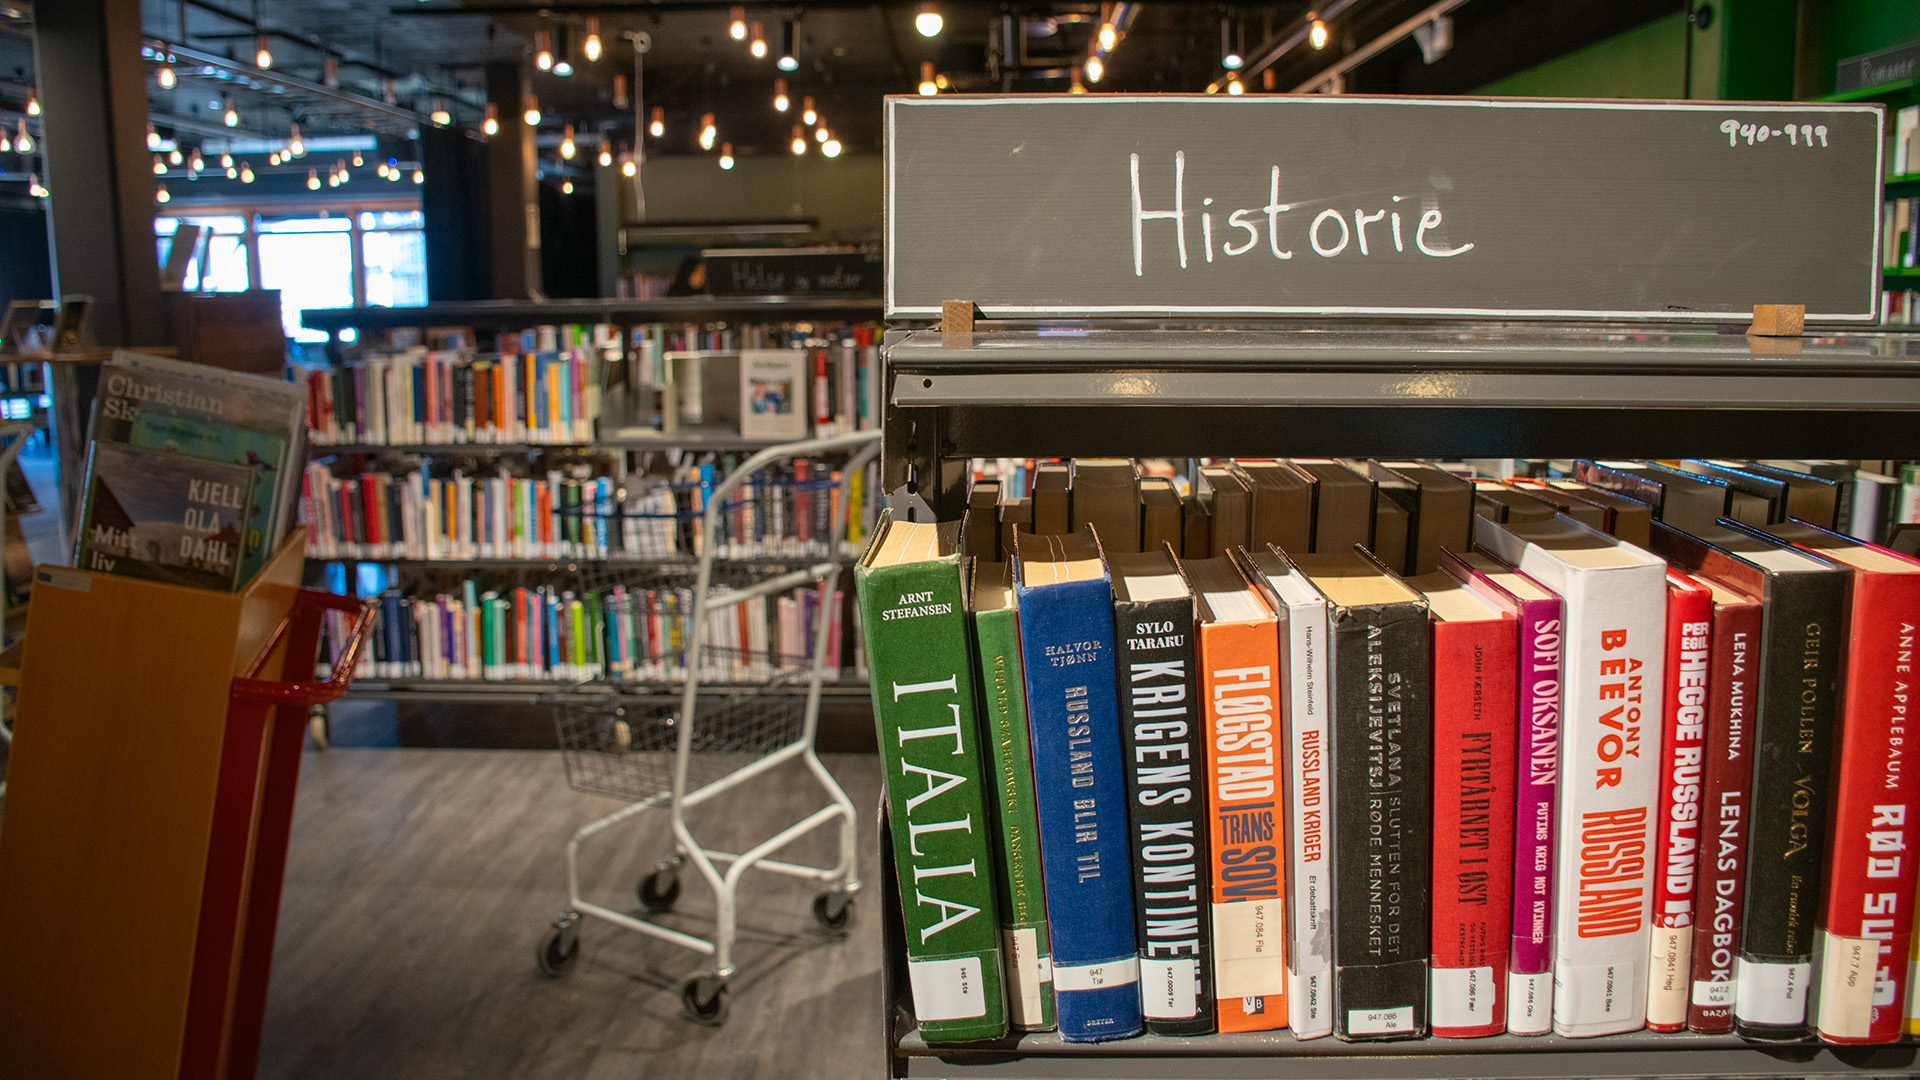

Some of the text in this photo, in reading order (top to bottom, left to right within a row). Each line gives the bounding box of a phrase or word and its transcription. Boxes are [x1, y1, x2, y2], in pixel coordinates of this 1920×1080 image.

[1720, 119, 1828, 147] 940-999
[1130, 150, 1475, 276] Historie
[106, 373, 224, 415] Christian
[188, 479, 243, 509] KJELL
[94, 524, 137, 549] Mitt
[184, 508, 220, 533] OLA
[91, 551, 115, 571] liv
[179, 535, 231, 566] DAHL
[882, 602, 952, 621] STEFANSEN
[898, 591, 934, 605] ARNT
[1045, 640, 1102, 657] HALVOR
[1127, 634, 1185, 651] TARARU
[1136, 620, 1174, 635] SYLO
[1681, 637, 1708, 650] EGIL
[1682, 622, 1709, 635] PER
[1051, 652, 1098, 667] TJØNN
[1305, 625, 1314, 716] Hans-Wilhelm Steinfeld
[994, 655, 1009, 715] WITOLD
[1473, 645, 1483, 721] JOHN FÆRSETH
[1530, 619, 1561, 785] SOFI OKSANEN
[1676, 650, 1708, 742] HEGGE
[1728, 632, 1747, 760] LENA MUKHINA
[1596, 629, 1627, 790] BEEVOR
[1626, 657, 1643, 758] ANTONY
[1884, 622, 1914, 789] ANNE APPLEBAUM
[1130, 660, 1193, 807] KRIGENS
[1213, 665, 1275, 801] FLØGSTAD
[1783, 622, 1821, 860] GEIR POLLEN VOLGA
[1064, 685, 1101, 884] RUSSLAND BLIR TIL
[1302, 730, 1321, 863] RUSSLAND KRIGER
[1367, 625, 1383, 957] ALEKSIJEVITSJ RØDE MENNESKET
[1459, 731, 1496, 849] FYRTÅRNET
[892, 673, 981, 946] ITALIA
[1219, 811, 1276, 846] TRANS-
[1387, 672, 1402, 955] SVETLANA SLUTTEN FOR DET
[1665, 746, 1703, 894] RUSSLAND
[1009, 824, 1027, 897] DANSENDE
[1866, 804, 1906, 878] RØD
[1457, 871, 1489, 906] ØST
[1532, 802, 1549, 945] PUTINS KRIG MOT KVINNER
[1577, 807, 1647, 939] RUSSLAND
[1711, 791, 1741, 982] LENAS DAGBOK
[1309, 875, 1317, 930] Et debattskrift
[1788, 892, 1799, 928] russisk
[1255, 905, 1264, 953] 947.084 Flø
[1786, 930, 1797, 954] reise
[960, 967, 968, 979] 945
[1089, 968, 1103, 977] 947
[1665, 934, 1677, 972] 947.0841
[1847, 945, 1861, 987] 947.7 App
[1092, 977, 1104, 986] Tjø
[1166, 967, 1174, 996] 947.0009
[1309, 975, 1317, 1019] 947.0842 Ste
[1663, 974, 1674, 991] Heg
[1785, 987, 1794, 999] Pol
[1367, 1013, 1397, 1021] 947.086
[1604, 998, 1613, 1012] Bee
